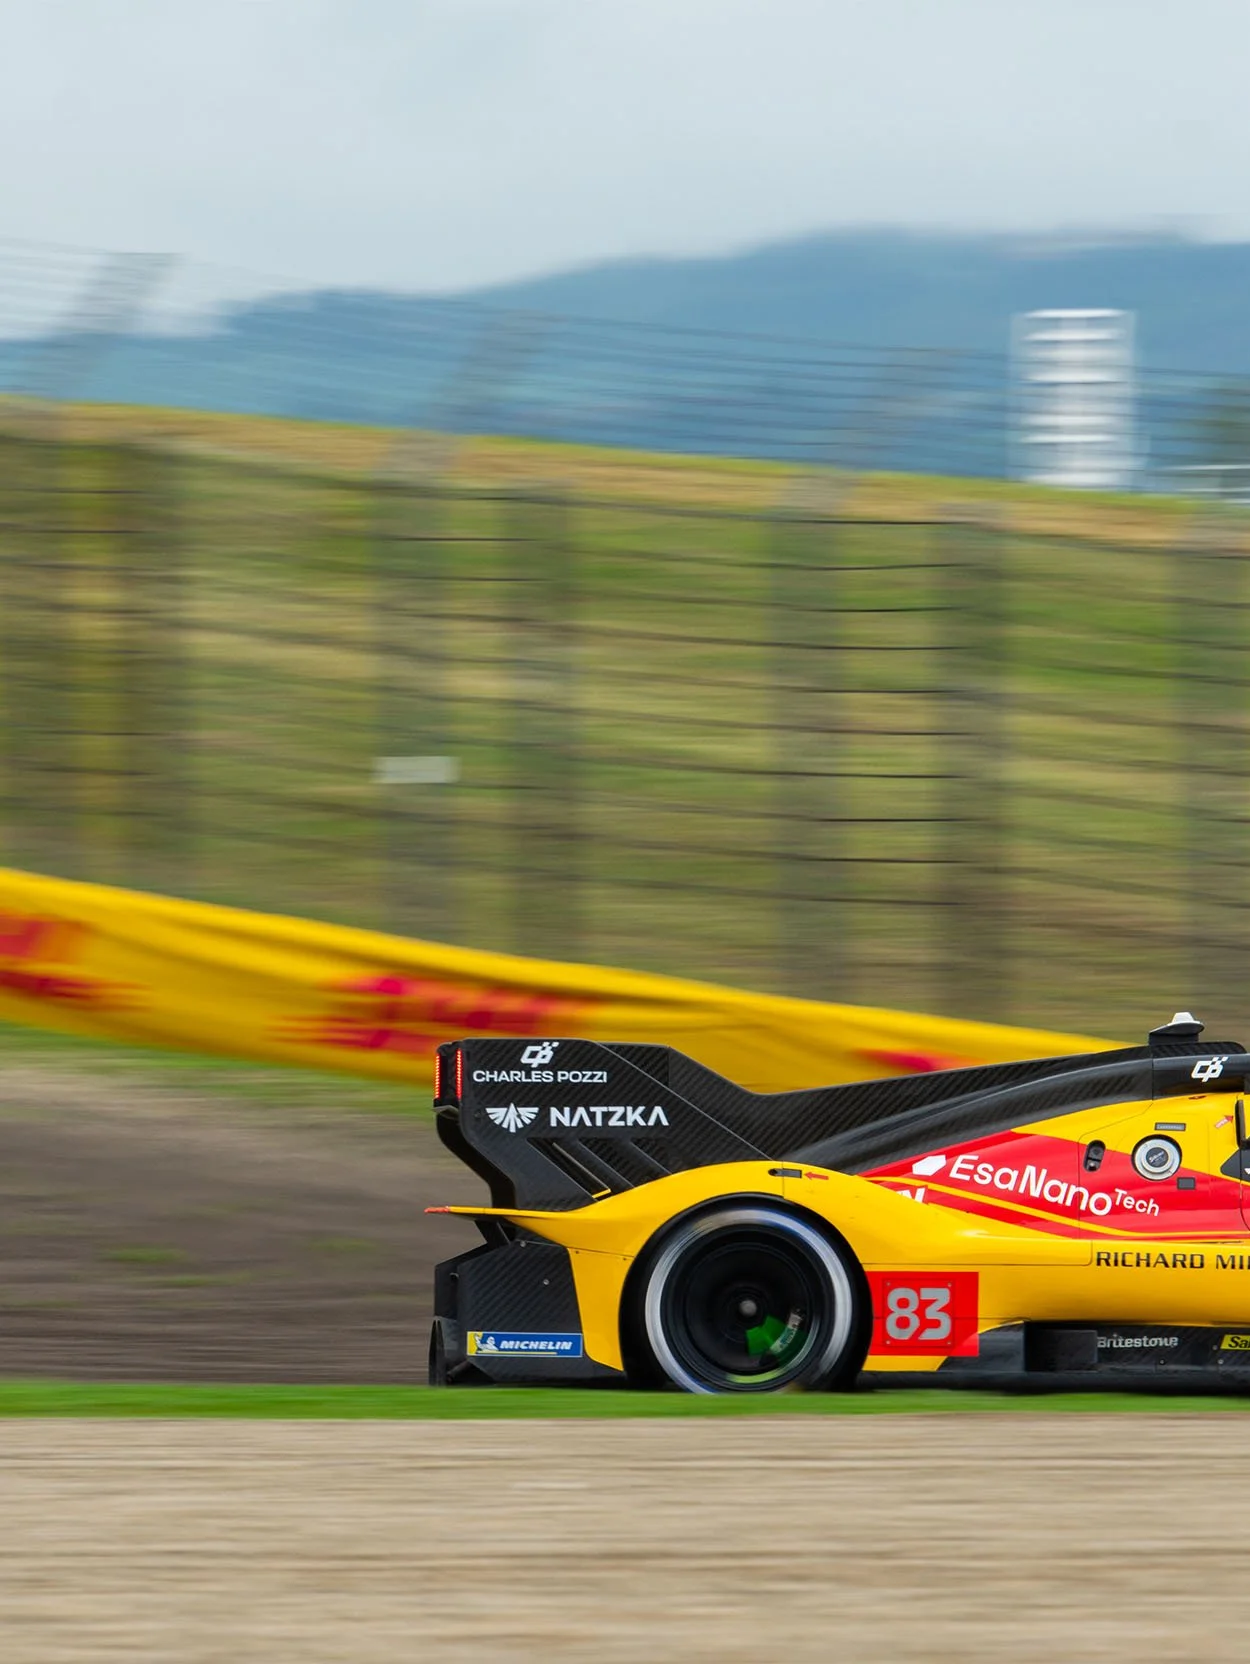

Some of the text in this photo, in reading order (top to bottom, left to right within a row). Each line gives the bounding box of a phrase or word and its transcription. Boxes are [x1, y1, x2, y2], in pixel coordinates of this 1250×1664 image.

[472, 1070, 608, 1083] CHARLES POZZI
[549, 1106, 670, 1127] NATZKA
[949, 1154, 1160, 1217] EsaNano Tech
[1096, 1251, 1205, 1269] RICHARD
[885, 1288, 951, 1340] 83
[500, 1340, 573, 1350] MICHELIN
